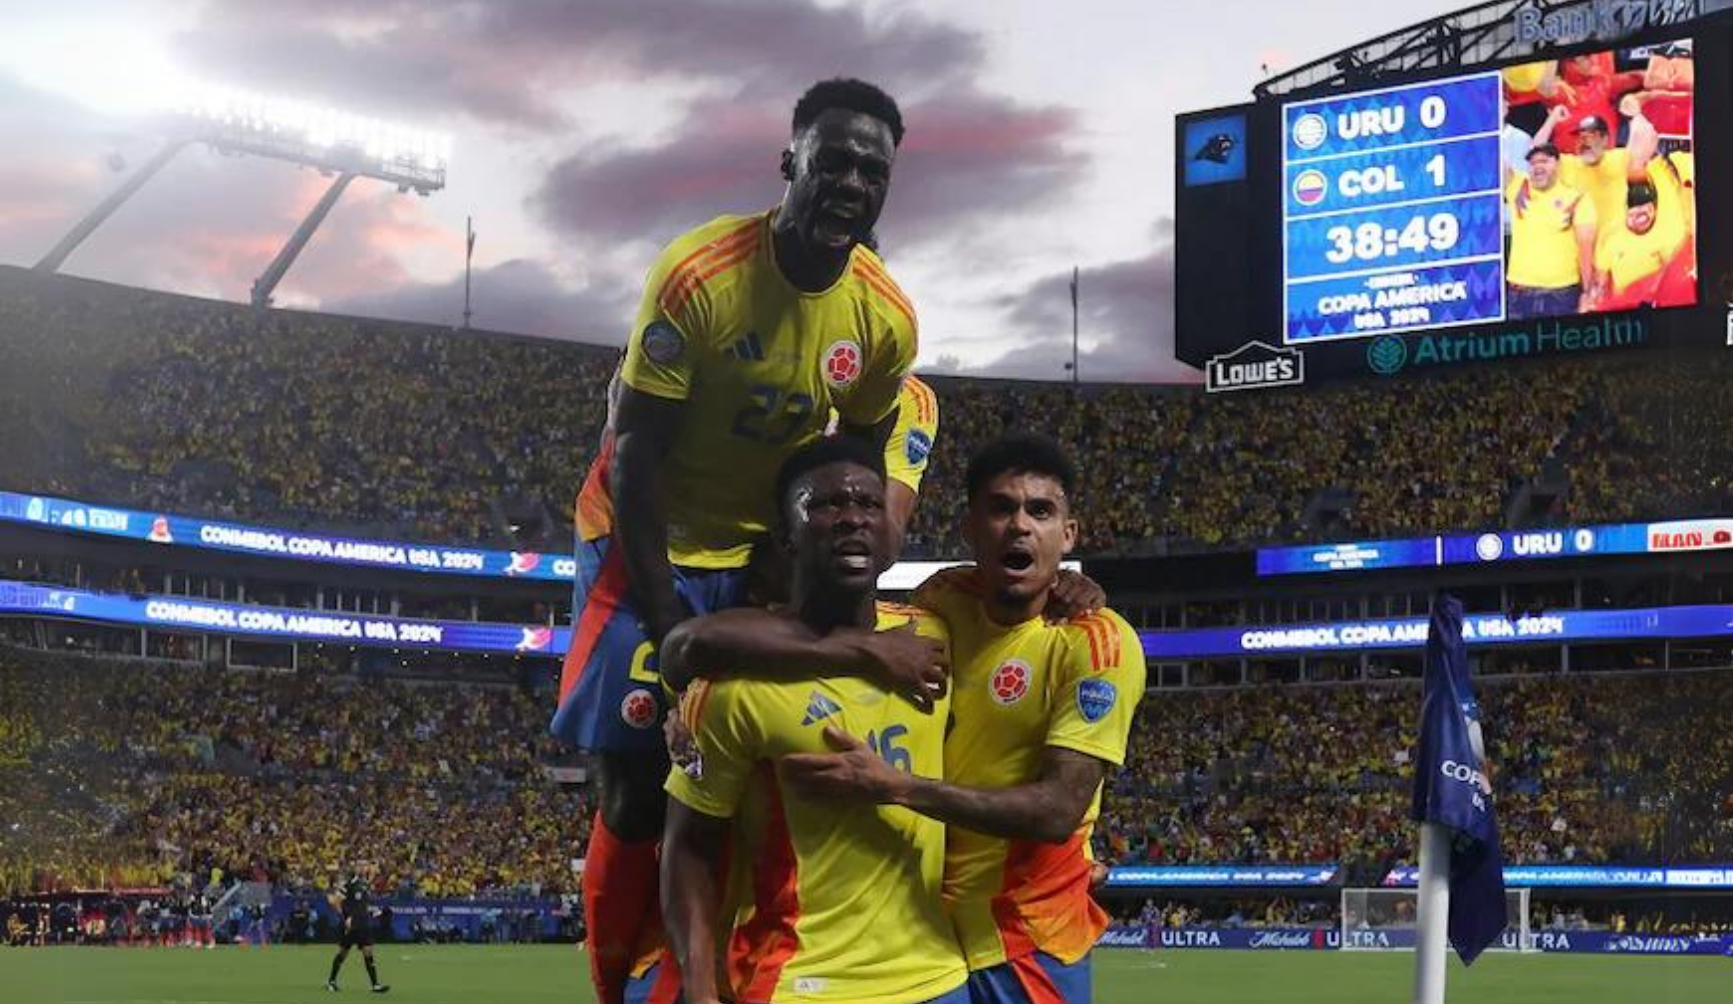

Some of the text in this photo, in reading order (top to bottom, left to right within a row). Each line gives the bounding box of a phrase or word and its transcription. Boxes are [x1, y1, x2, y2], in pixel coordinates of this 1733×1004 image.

[1337, 96, 1447, 140] URU 0
[1338, 154, 1446, 196] COL 1
[1325, 212, 1460, 263] 38:49
[1318, 293, 1372, 315] COPA
[1374, 281, 1467, 309] AMERICA
[1414, 331, 1530, 364] Atrium
[1216, 357, 1293, 386] LOWE'S
[288, 537, 334, 557] COPA
[333, 541, 406, 565] AMERICA
[408, 549, 441, 567] USA
[442, 552, 484, 570] 2024
[1513, 528, 1594, 555] URU 0
[239, 611, 286, 631] COPA
[286, 615, 362, 637] AMERICA
[364, 621, 397, 640] USA
[398, 623, 443, 642] 2024
[1340, 624, 1393, 645] COPA
[1479, 616, 1515, 637] USA
[1516, 616, 1565, 635] 2024
[1161, 931, 1220, 946] ULTRA
